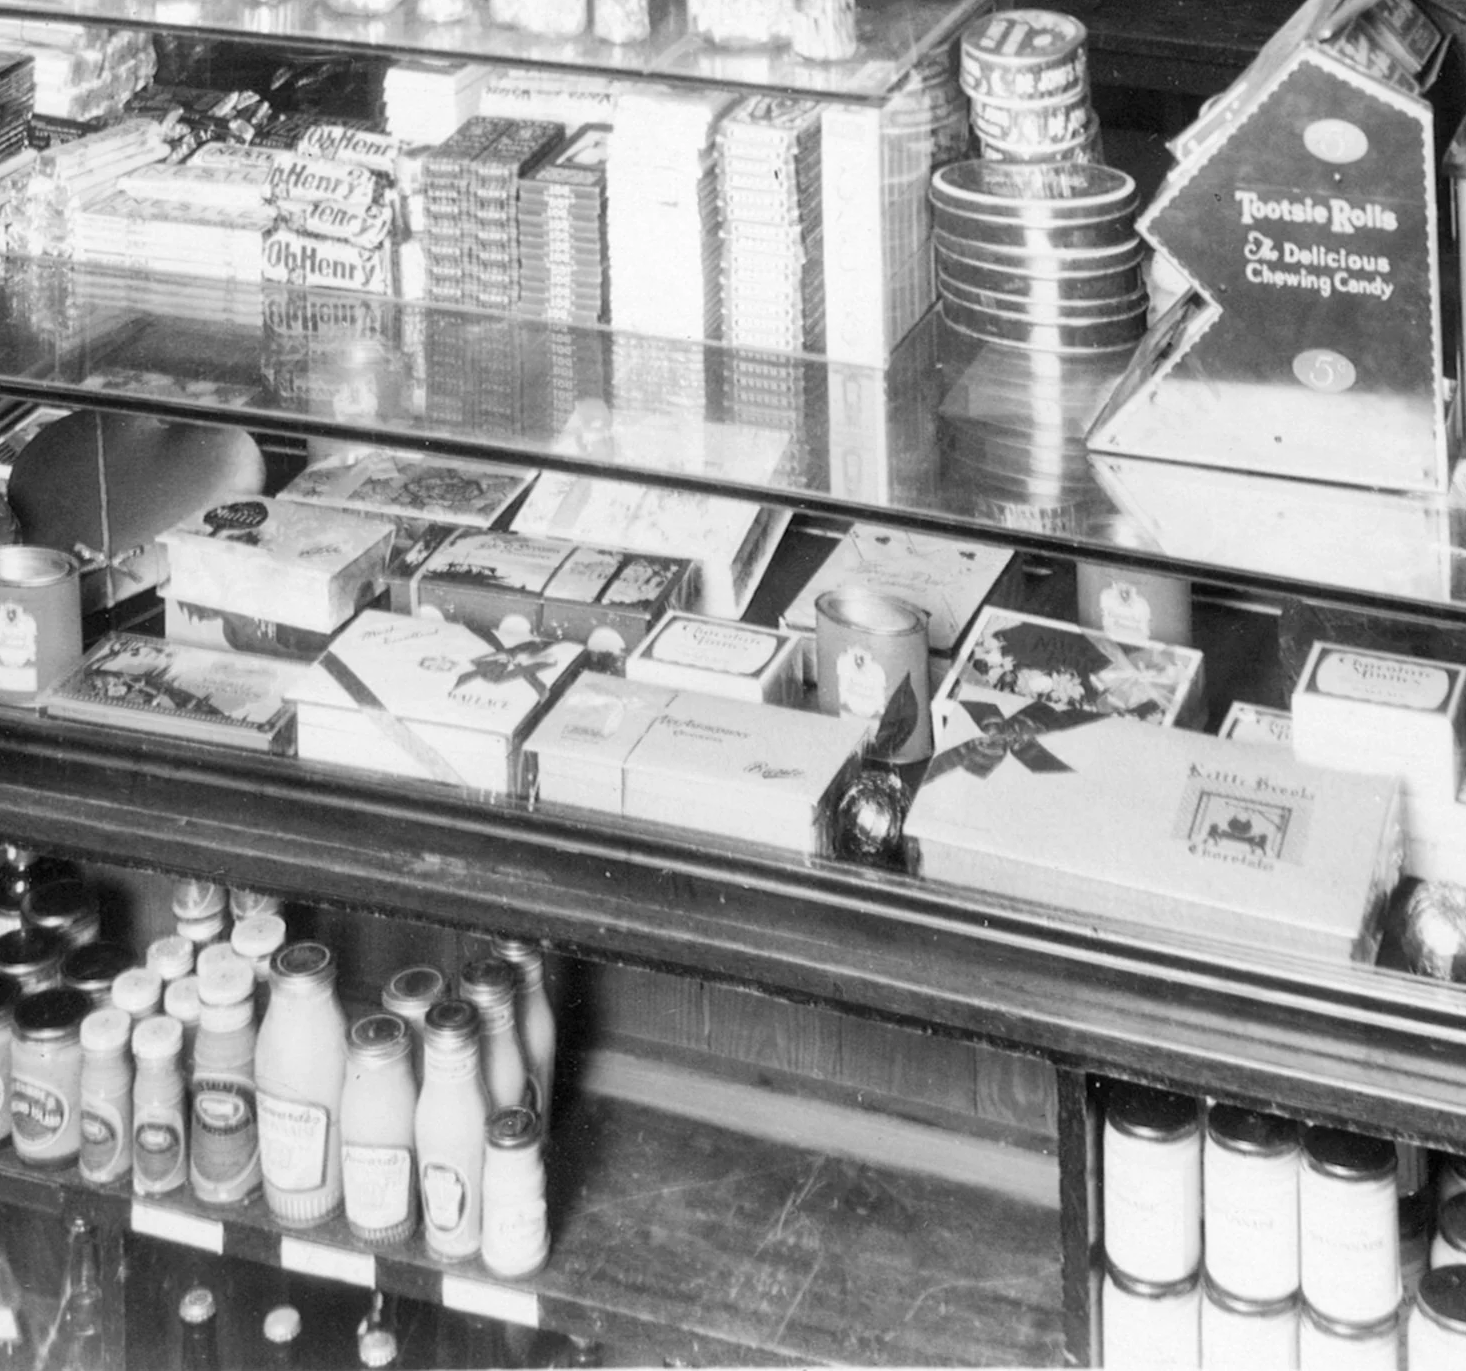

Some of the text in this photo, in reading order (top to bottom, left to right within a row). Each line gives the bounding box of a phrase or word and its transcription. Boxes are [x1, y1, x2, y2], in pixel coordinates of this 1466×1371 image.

[1235, 190, 1399, 234] Tootsie Rolls
[1244, 231, 1391, 274] The Delicious
[1245, 262, 1394, 301] Chewing Candy
